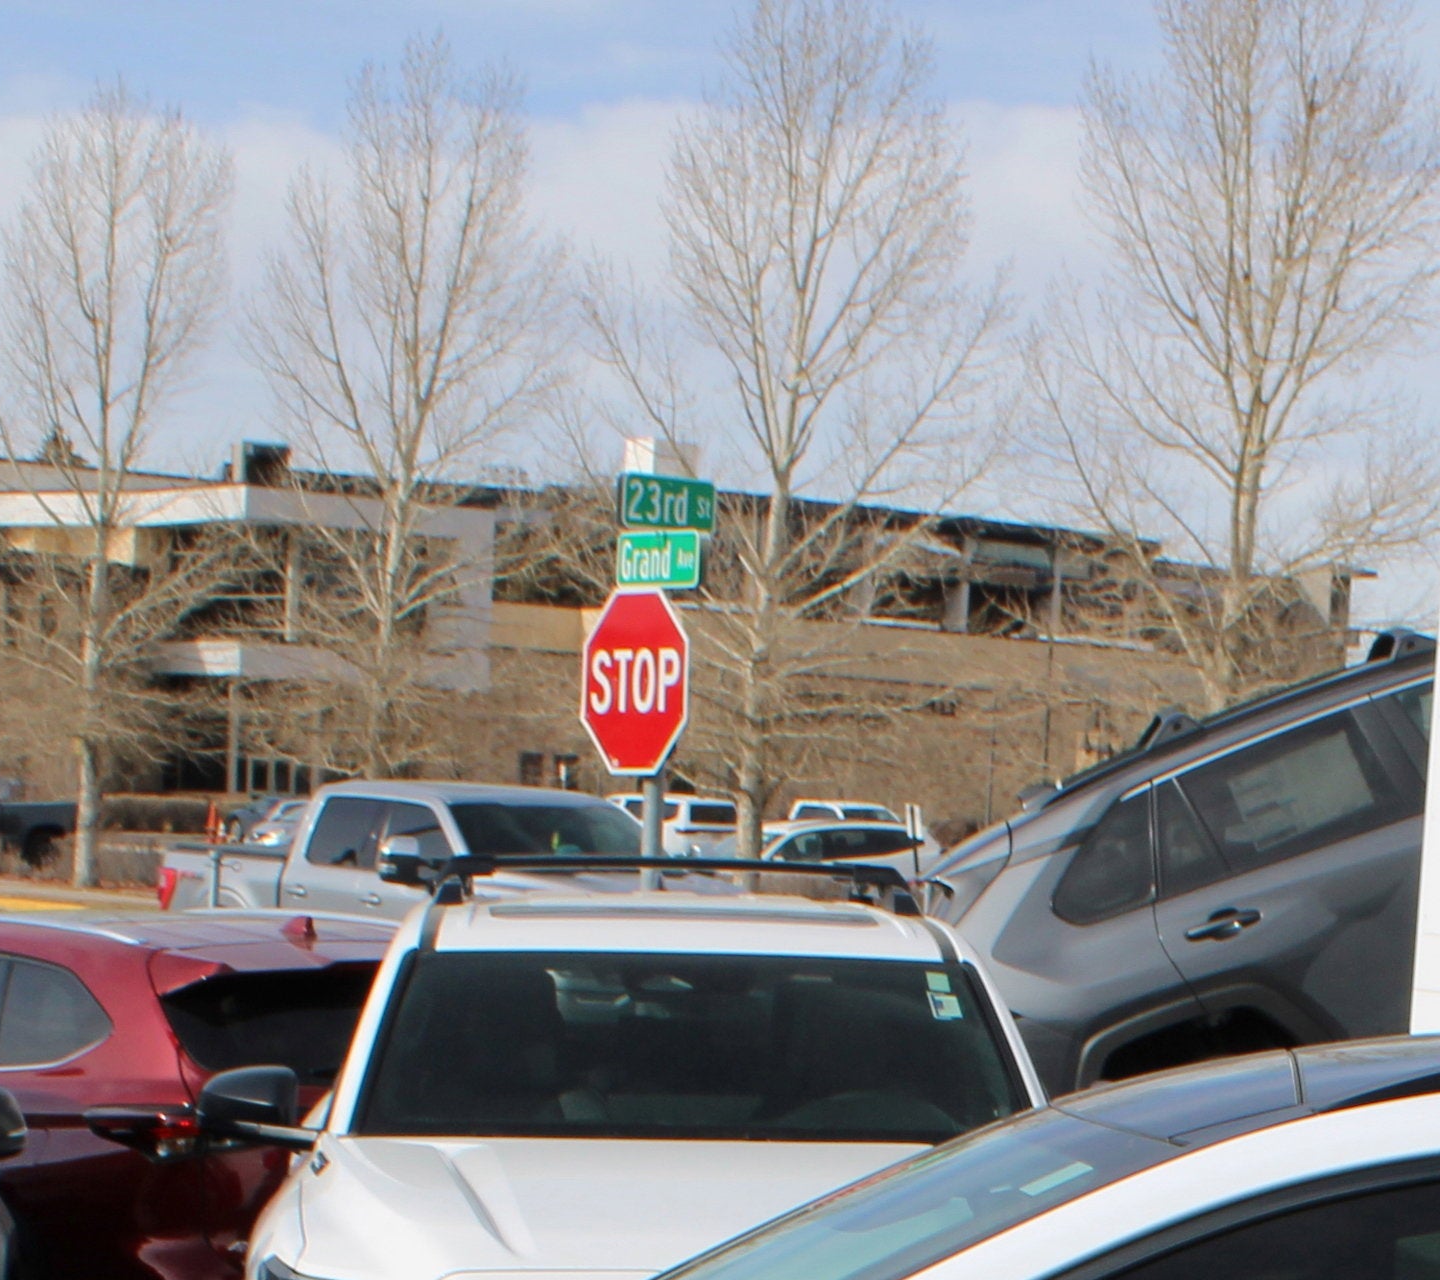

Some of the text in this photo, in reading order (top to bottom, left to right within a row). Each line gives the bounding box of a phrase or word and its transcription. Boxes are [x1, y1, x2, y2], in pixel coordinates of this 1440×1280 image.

[627, 479, 689, 527] 23rd
[620, 539, 695, 582] Grand Ave
[590, 648, 681, 714] STOP
